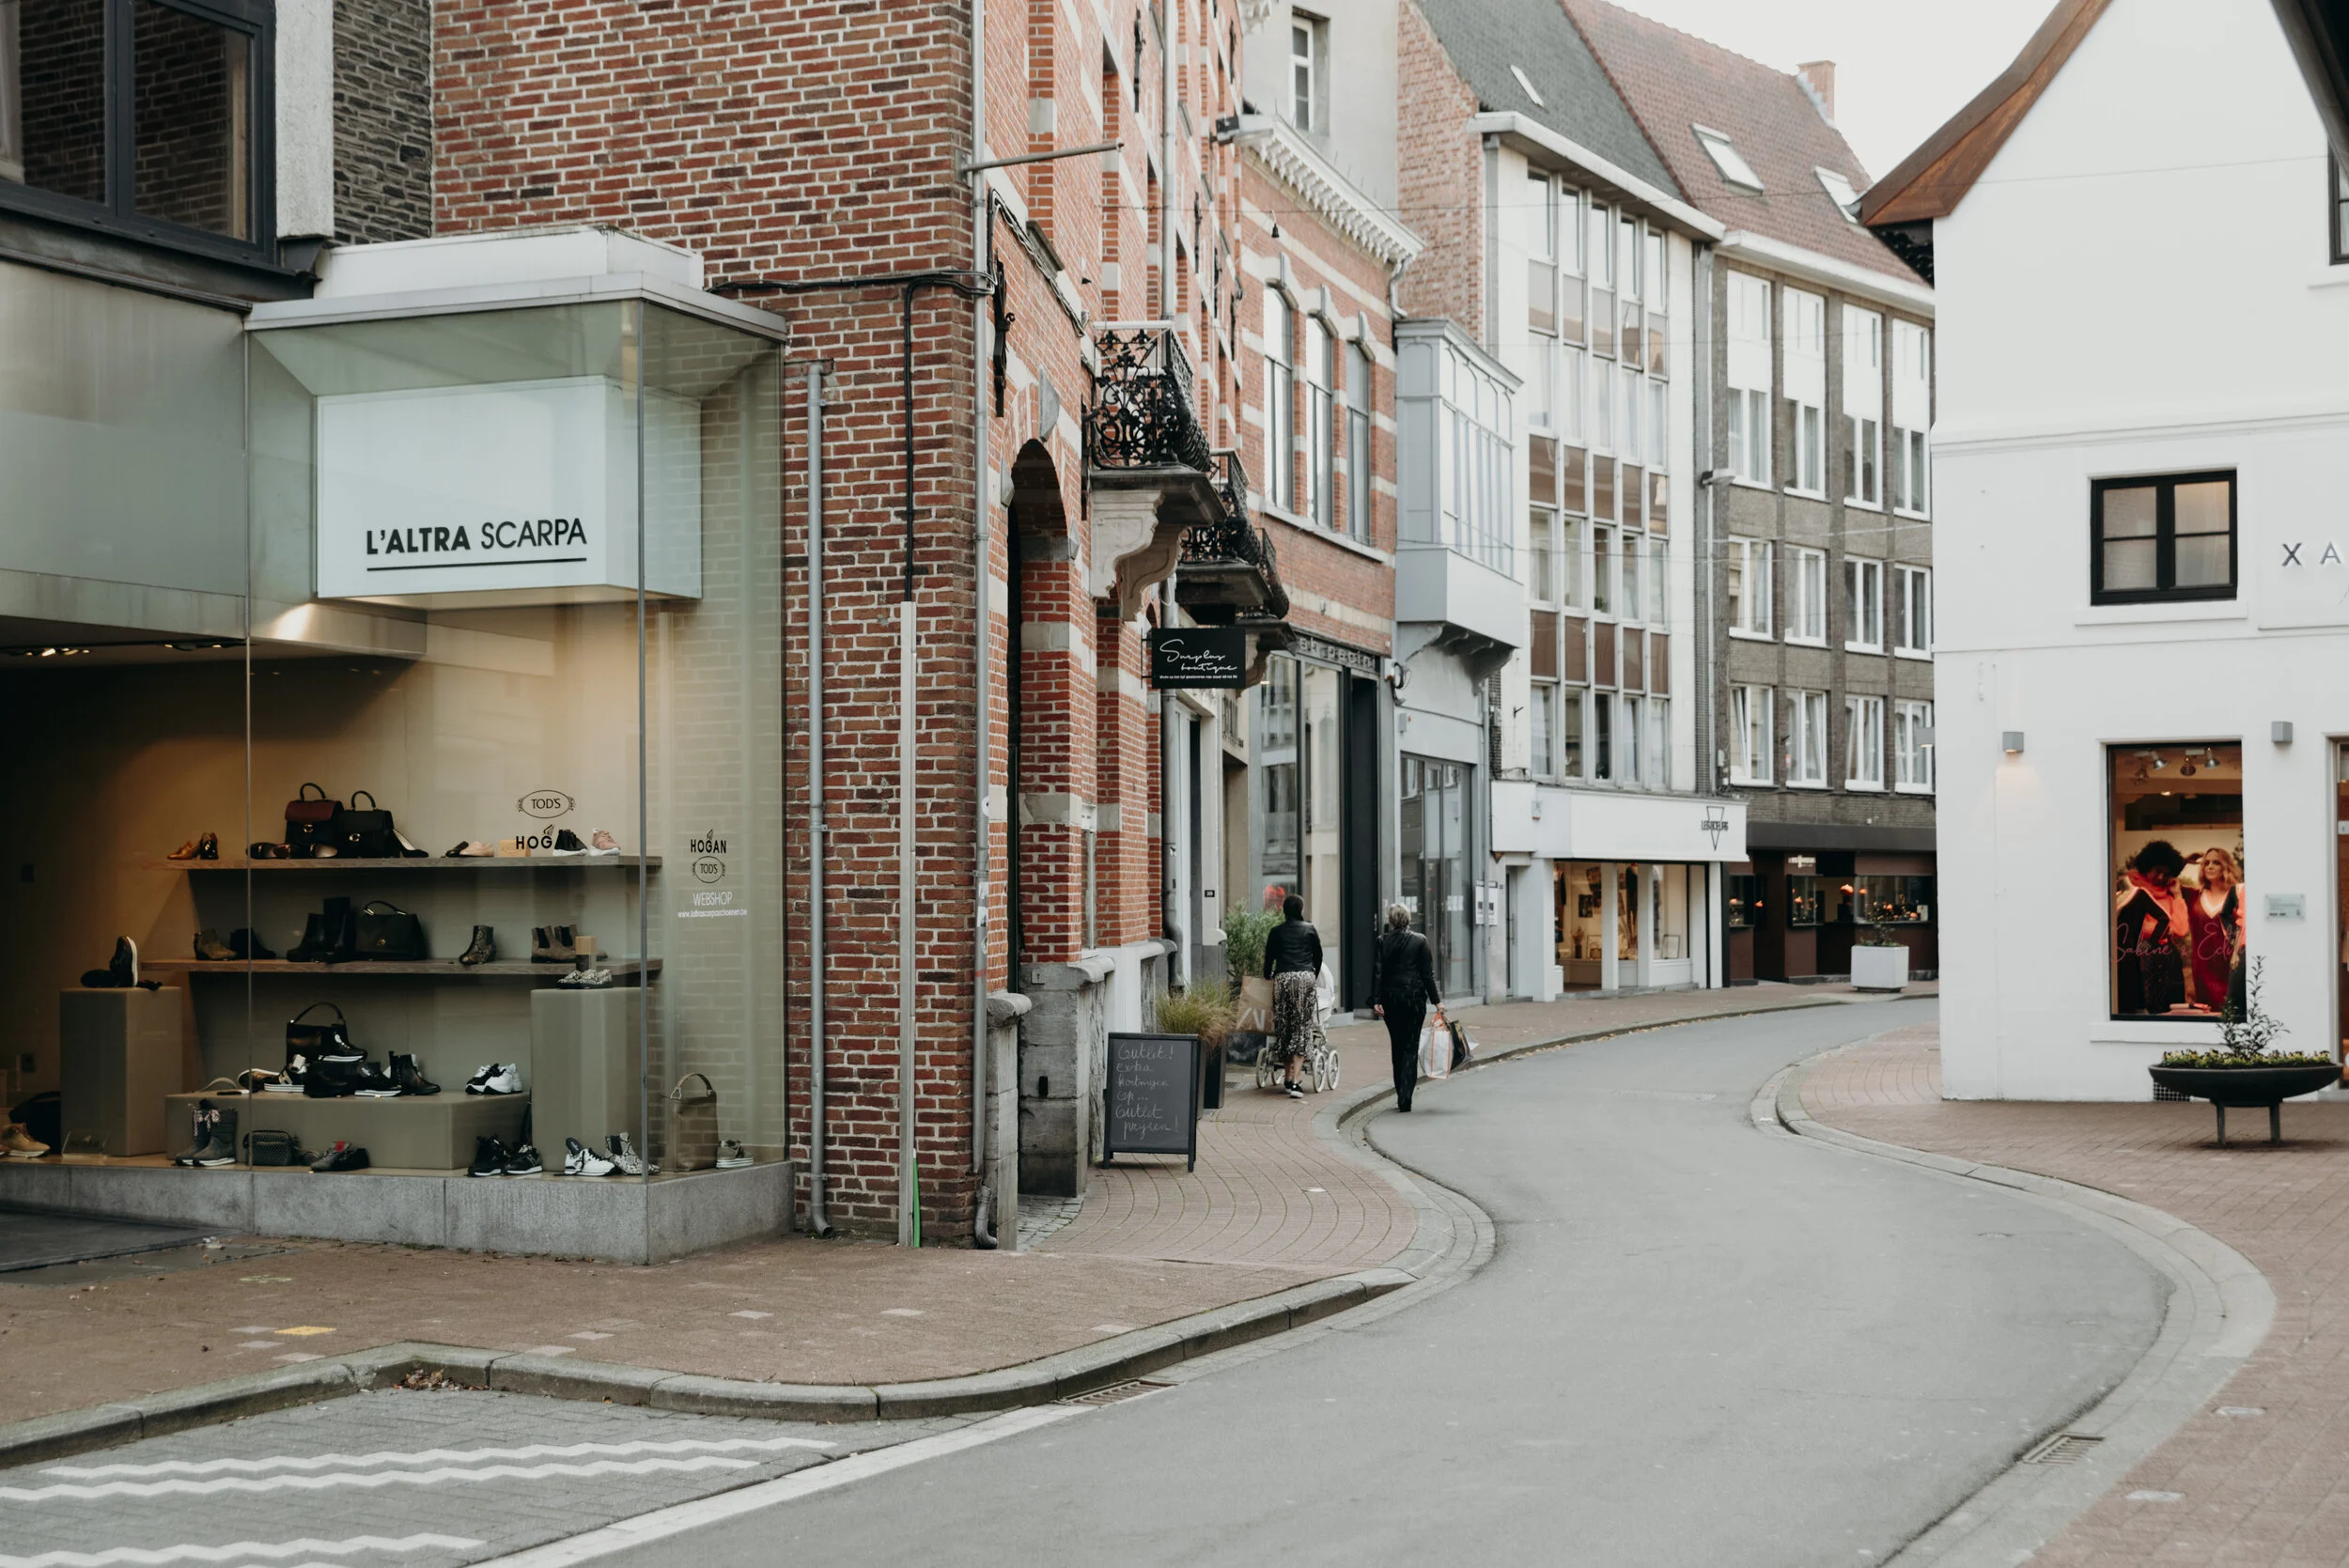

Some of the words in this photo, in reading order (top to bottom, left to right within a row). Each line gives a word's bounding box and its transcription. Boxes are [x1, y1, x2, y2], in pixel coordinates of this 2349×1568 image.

[366, 525, 472, 555] L'ALTRA
[481, 518, 587, 550] SCARPA
[1159, 639, 1226, 663] Surplus
[1181, 662, 1238, 675] boutique
[531, 799, 562, 810] TOD'S
[691, 839, 727, 854] HOGAN
[700, 863, 719, 875] TOD'S
[692, 892, 733, 907] WEBSHOP
[1115, 1103, 1163, 1119] Outlet
